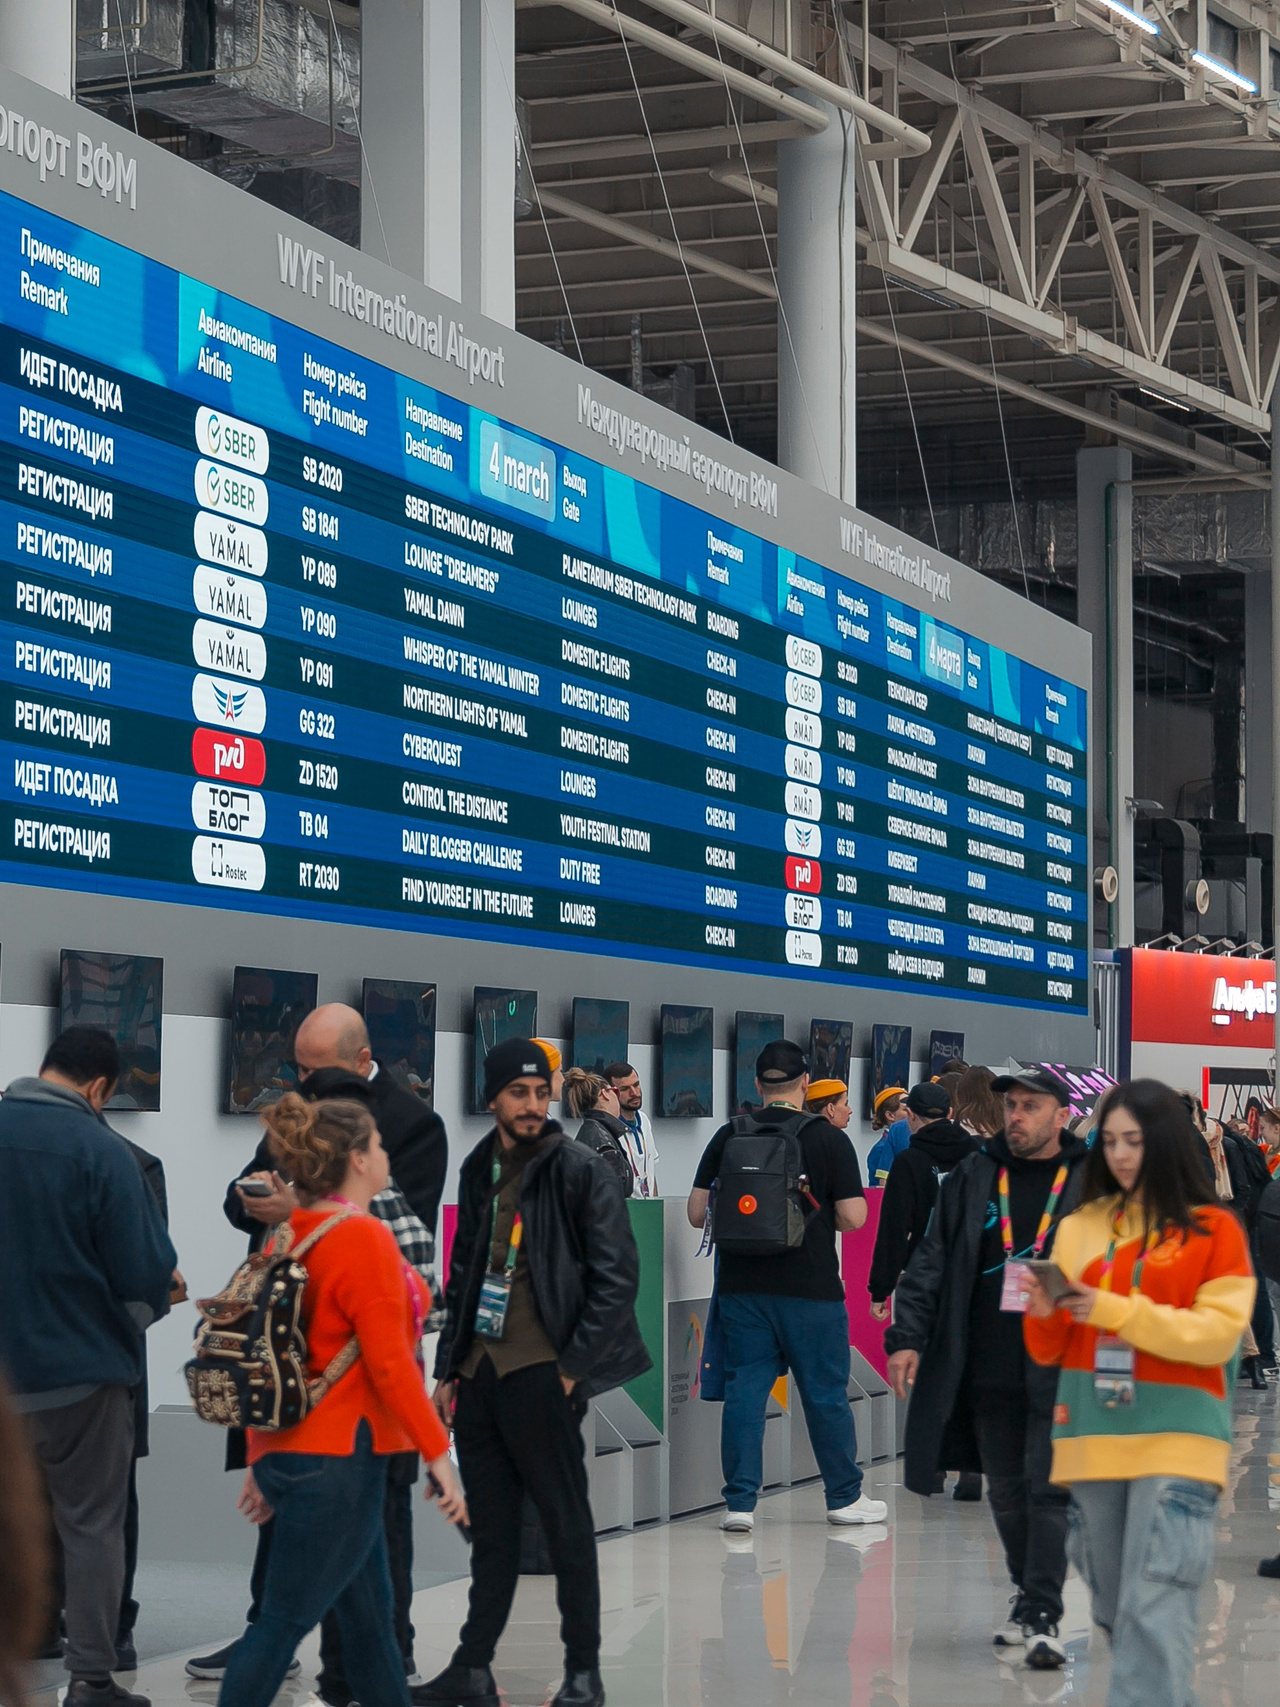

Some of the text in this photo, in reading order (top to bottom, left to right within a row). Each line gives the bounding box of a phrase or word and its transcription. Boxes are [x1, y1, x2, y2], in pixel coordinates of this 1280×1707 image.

[76, 132, 138, 210] ВФМ
[20, 228, 100, 287] Примечания
[20, 271, 68, 315] Remark
[277, 233, 505, 387] WYF International Airport
[198, 308, 277, 364] Авиакомпания
[21, 348, 122, 412] ИДЕТ ПОСАДКА
[198, 347, 233, 383] Airline
[303, 353, 367, 401] Номер рейса
[303, 390, 368, 437] Flight number
[405, 396, 463, 442] Направление
[224, 426, 256, 461] SBER
[405, 431, 453, 472] Destination
[577, 383, 778, 518] Международный аэропорт ВФМ
[303, 457, 342, 491] SB 2020
[489, 442, 550, 502] 4 march
[563, 465, 588, 498] Выход
[19, 464, 112, 520] РЕГИСТРАЦИЯ
[223, 478, 255, 512] SBER
[563, 497, 580, 523] Gate
[406, 495, 513, 555] SBER TECHNOLOGY PARK
[18, 523, 111, 576] РЕГИСТРАЦИЯ
[210, 531, 252, 569] YAMAL
[839, 516, 863, 557] WYF
[864, 529, 920, 588] International
[921, 558, 951, 603] Airport
[707, 559, 730, 585] Remark
[209, 585, 252, 621] YAMAL
[404, 588, 464, 628] YAMAL DAWN
[563, 598, 597, 628] LOUNGES
[301, 607, 335, 638] YP 090
[708, 611, 738, 639] BOARDING
[16, 641, 110, 691] РЕГИСТРАЦИЯ
[208, 639, 252, 674] YAMAL
[707, 650, 736, 676] CHECK-IN
[930, 637, 935, 662] 4
[937, 645, 961, 679] марта
[16, 701, 110, 748] РЕГИСТРАЦИЯ
[793, 721, 814, 743] ЯМАЛ
[403, 734, 461, 766] CYBERQUEST
[16, 760, 118, 807] ИДЕТ ПОСАДКА
[300, 760, 337, 790] ZD 1520
[793, 758, 814, 780] ЯМАЛ
[209, 788, 250, 811] ТОП
[403, 782, 507, 823] CONTROL THE DISTANCE
[793, 795, 813, 816] ЯМАЛ
[209, 810, 250, 832] БЛОГ
[561, 814, 650, 852] YOUTH FESTIVAL STATION
[403, 830, 522, 871] DAILY BLOGGER CHALLENGE
[225, 864, 247, 881] Rostec
[300, 863, 339, 890] RT 2030
[561, 858, 600, 884] DUTY FREE
[561, 902, 595, 926] LOUNGES
[706, 926, 734, 947] CHECK-IN
